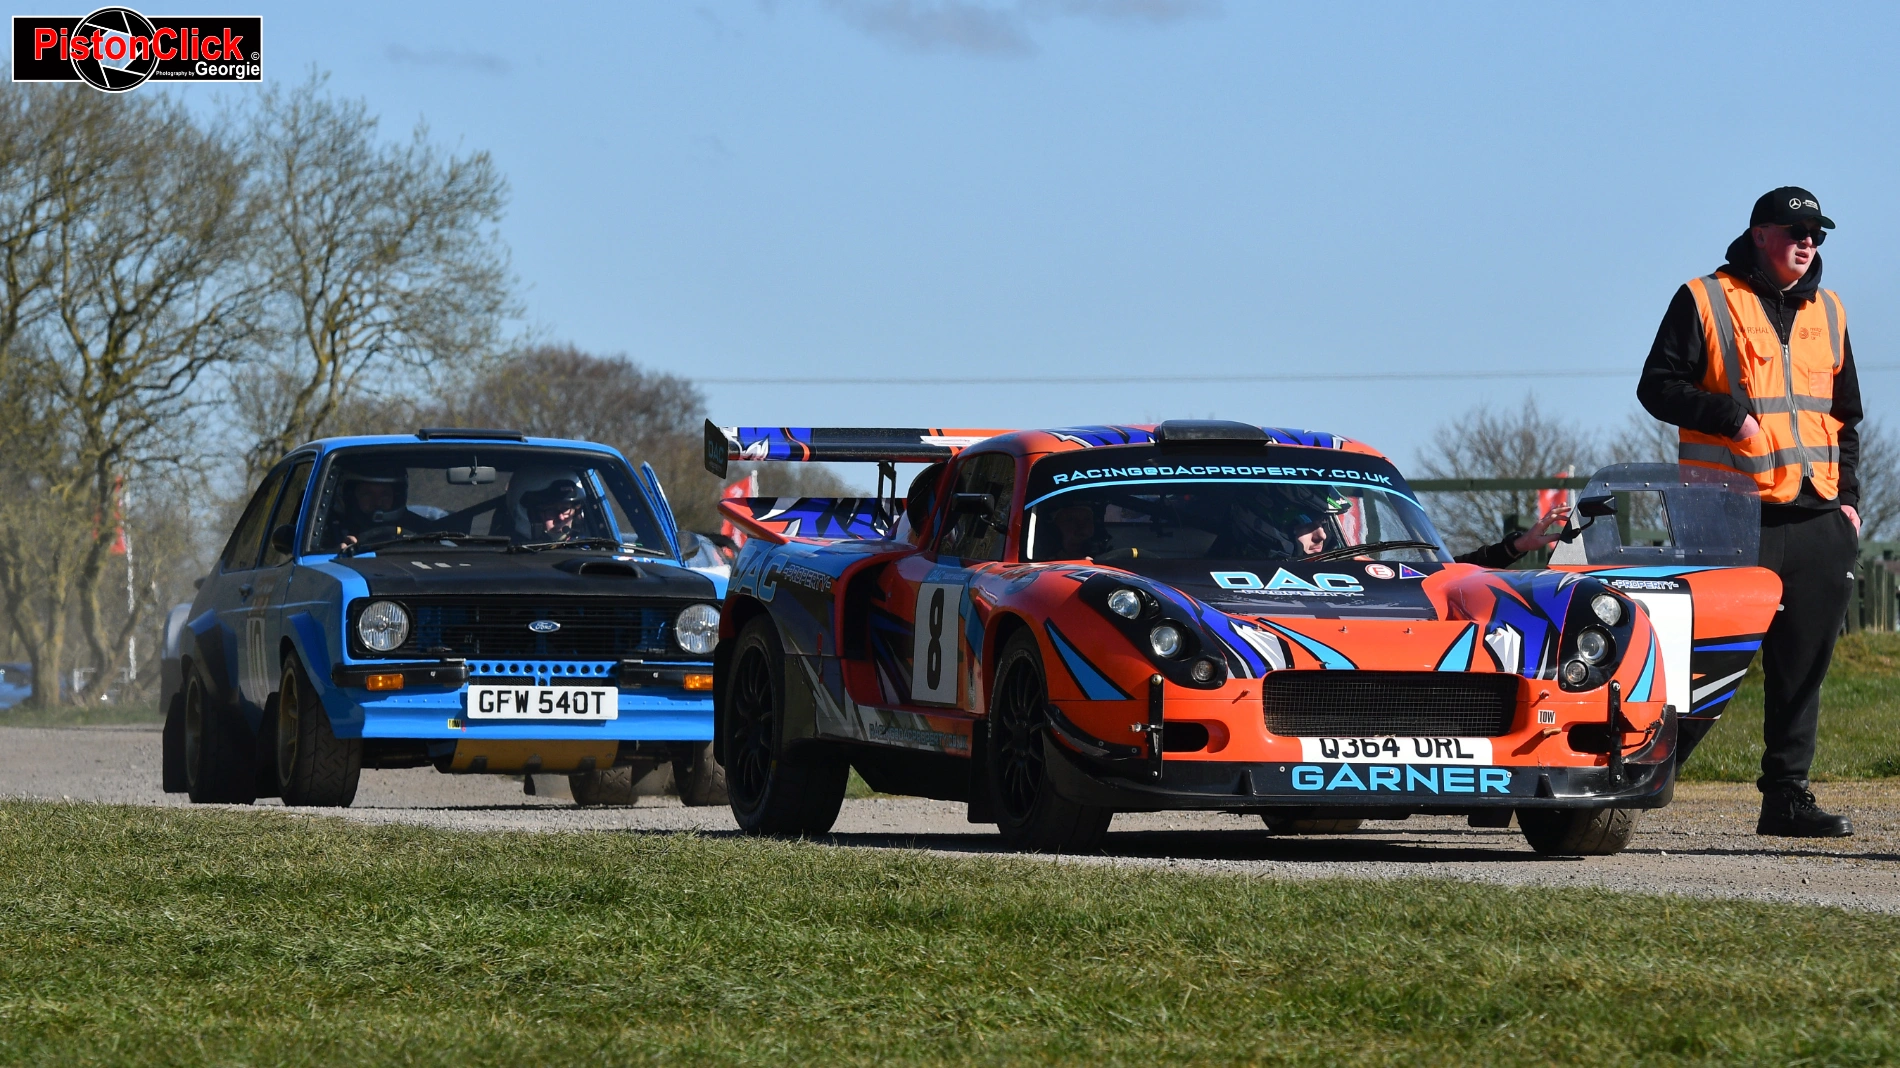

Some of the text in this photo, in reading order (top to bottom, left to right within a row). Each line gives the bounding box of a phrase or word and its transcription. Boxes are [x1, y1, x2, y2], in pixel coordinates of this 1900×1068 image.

[708, 440, 724, 464] DAC
[1052, 465, 1393, 486] RACING@DACPROPERTY.CO.UK
[728, 544, 790, 602] DAC
[1210, 567, 1364, 592] DAC
[926, 588, 945, 690] 8
[478, 690, 606, 714] GFW 540T
[1539, 710, 1555, 724] TOW
[1319, 737, 1400, 759] Q364
[1291, 762, 1511, 794] GARNER
